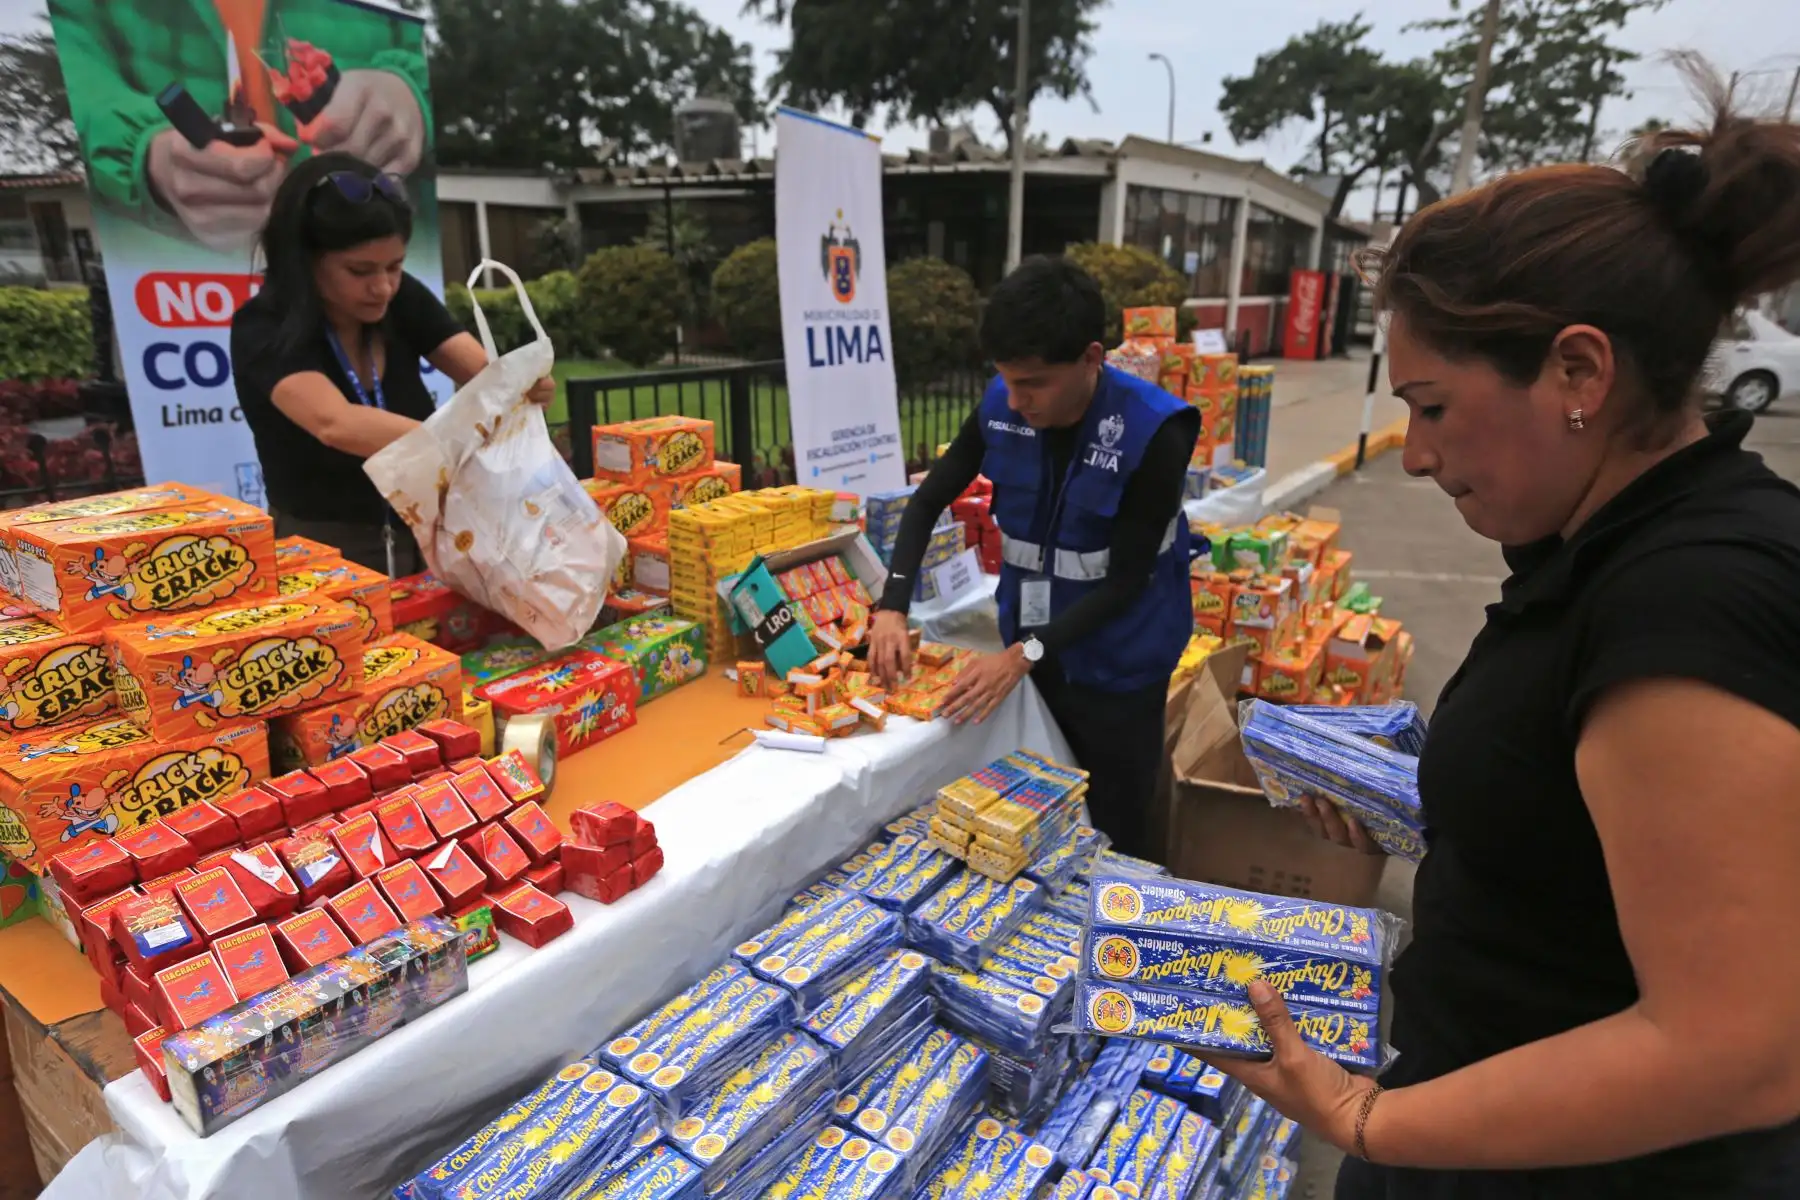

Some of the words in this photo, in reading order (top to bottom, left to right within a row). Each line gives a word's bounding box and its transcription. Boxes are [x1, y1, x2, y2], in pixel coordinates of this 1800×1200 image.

[153, 281, 234, 323] NO
[806, 325, 885, 367] LIMA
[142, 341, 231, 391] CO
[161, 406, 223, 428] Lima
[140, 540, 213, 583] CRICK
[23, 647, 106, 700] CRICK
[228, 641, 300, 689] CRICK
[38, 665, 115, 718] CRAC
[121, 754, 203, 811] CRICK
[1140, 884, 1186, 900] Sparklers
[1144, 896, 1236, 926] Mariposa
[1262, 905, 1346, 941] Chispitas
[1137, 936, 1184, 953] Sparklers
[1141, 948, 1234, 981] Mariposa
[1132, 990, 1179, 1007] Sparklers
[1136, 1002, 1231, 1036] Mariposa
[478, 1139, 524, 1194] Chispitas
[612, 1147, 642, 1170] Sparklers
